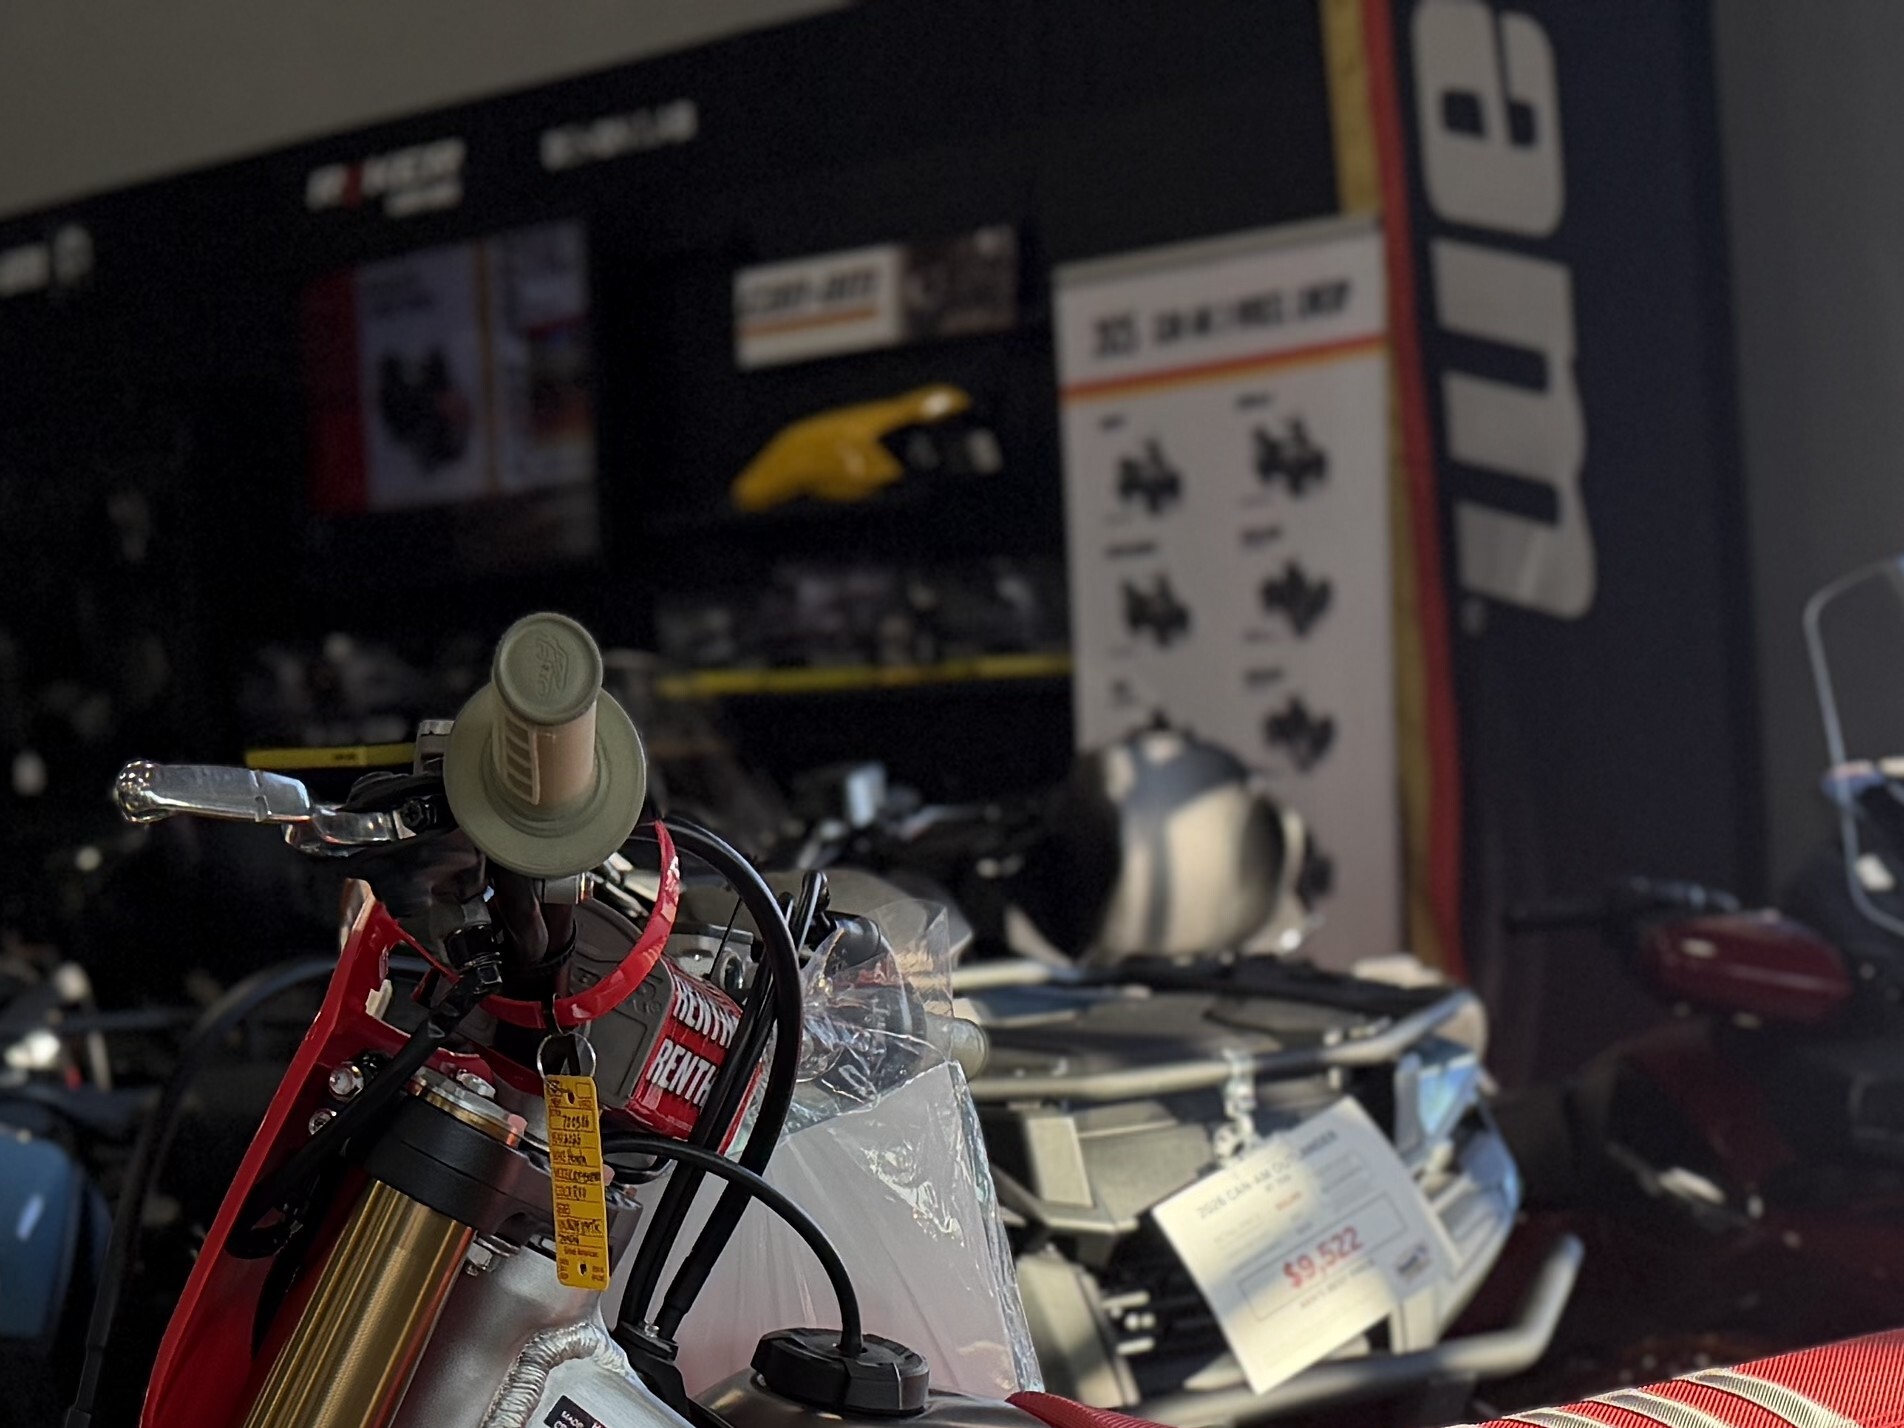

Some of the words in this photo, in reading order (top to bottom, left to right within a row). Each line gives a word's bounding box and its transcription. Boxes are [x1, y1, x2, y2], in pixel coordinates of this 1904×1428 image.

[673, 974, 741, 1049] RENTH
[646, 1038, 720, 1109] RENTH
[1283, 1226, 1363, 1289] $9,522
